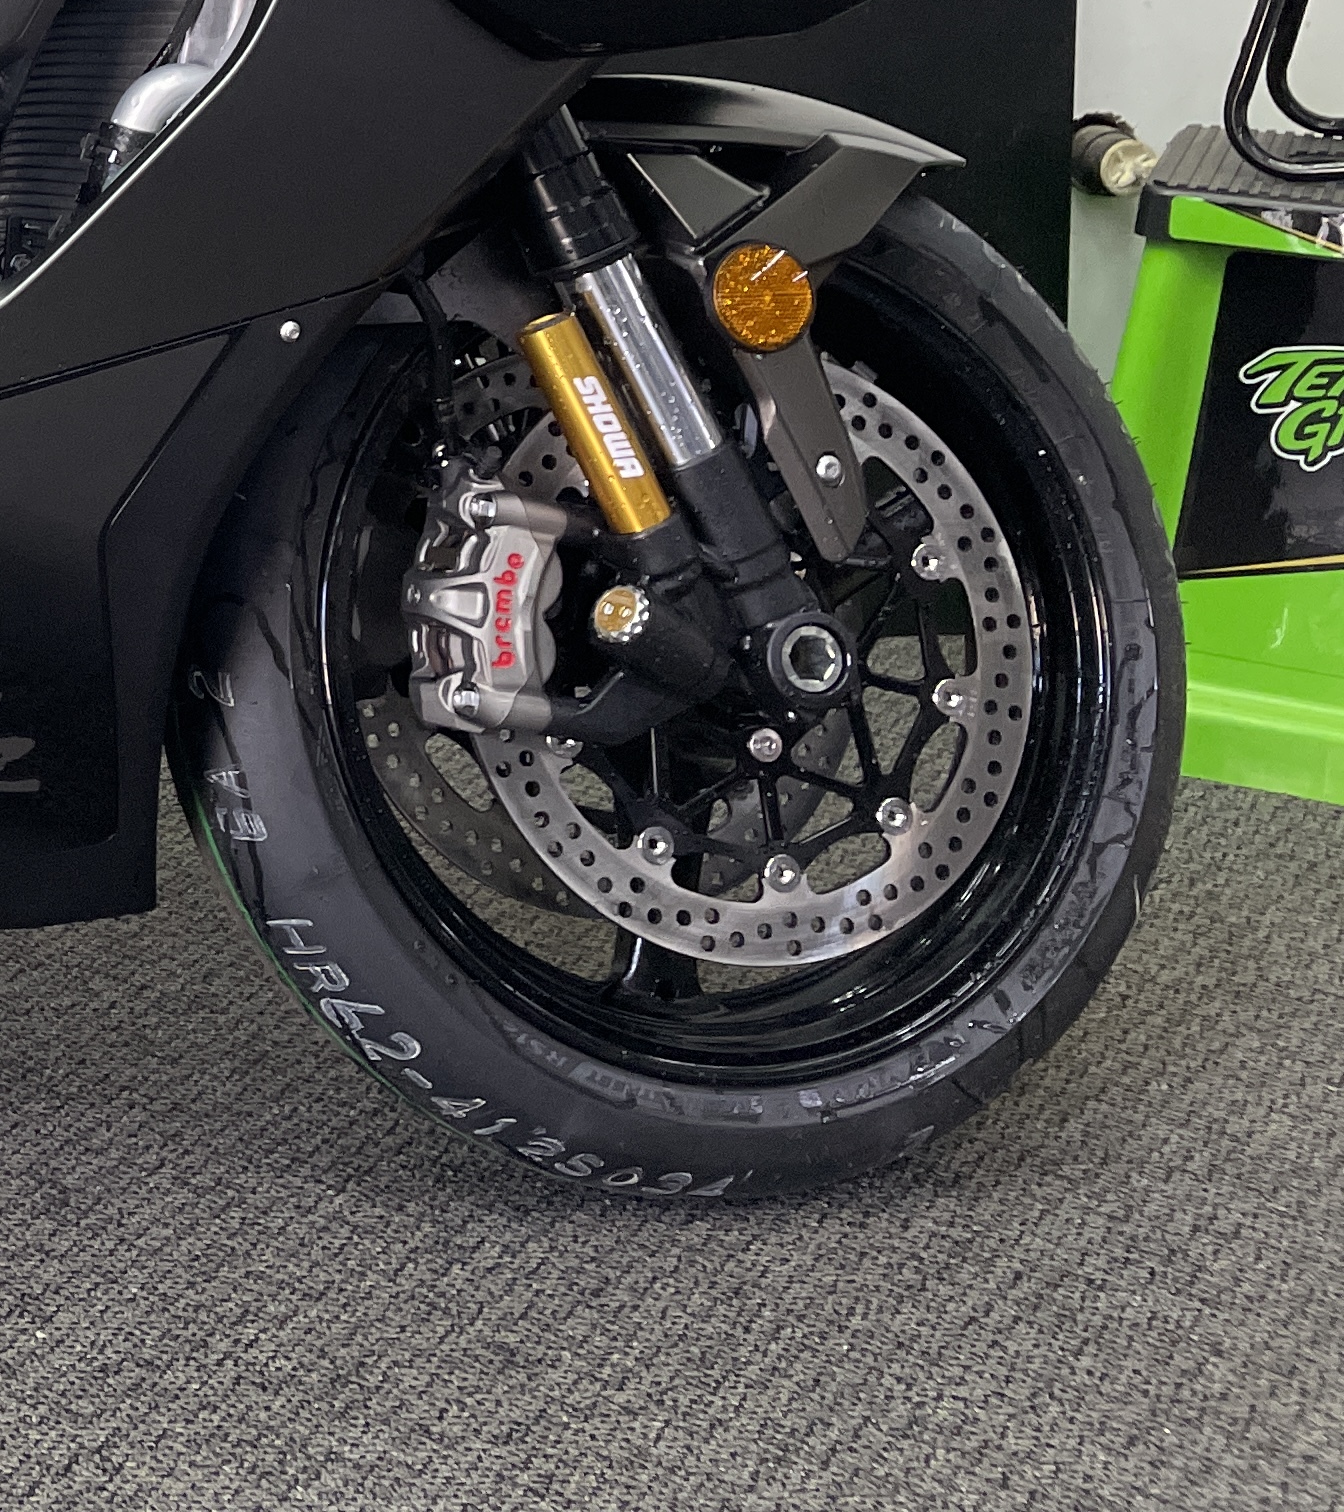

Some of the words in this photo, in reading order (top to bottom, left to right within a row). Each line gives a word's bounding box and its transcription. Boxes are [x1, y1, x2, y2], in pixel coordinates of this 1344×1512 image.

[573, 375, 645, 479] SHOWA
[1246, 351, 1344, 404] TE
[491, 552, 525, 669] brembo
